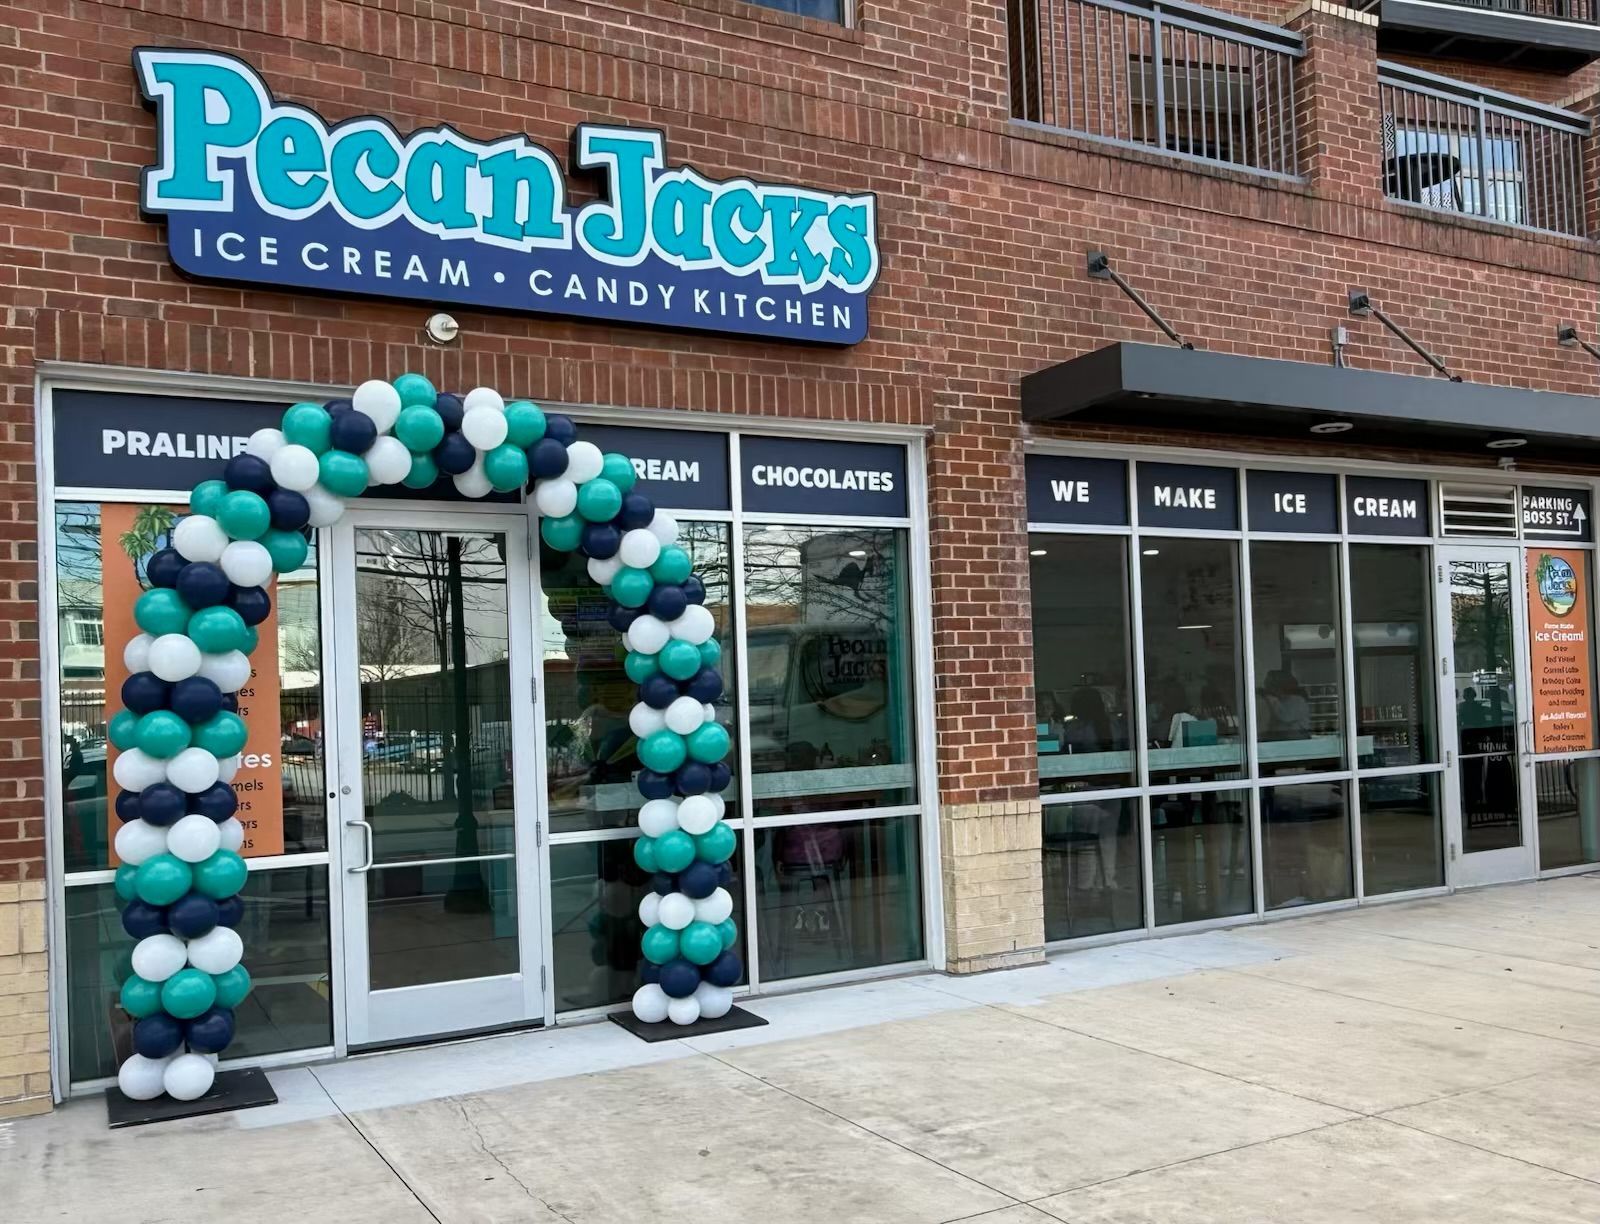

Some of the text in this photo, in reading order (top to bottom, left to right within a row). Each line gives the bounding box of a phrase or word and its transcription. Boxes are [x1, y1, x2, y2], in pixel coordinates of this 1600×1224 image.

[147, 57, 874, 287] Pecan Jacks
[193, 228, 852, 330] ICE CREAM CANDY KITCHEN
[630, 458, 700, 483] REAM
[751, 464, 894, 493] CHOCOLATES
[1050, 479, 1417, 519] WE MAKE ICE CREAM
[1522, 495, 1573, 511] PARKING
[1523, 510, 1573, 526] BOSS ST.
[1535, 630, 1550, 641] Ice
